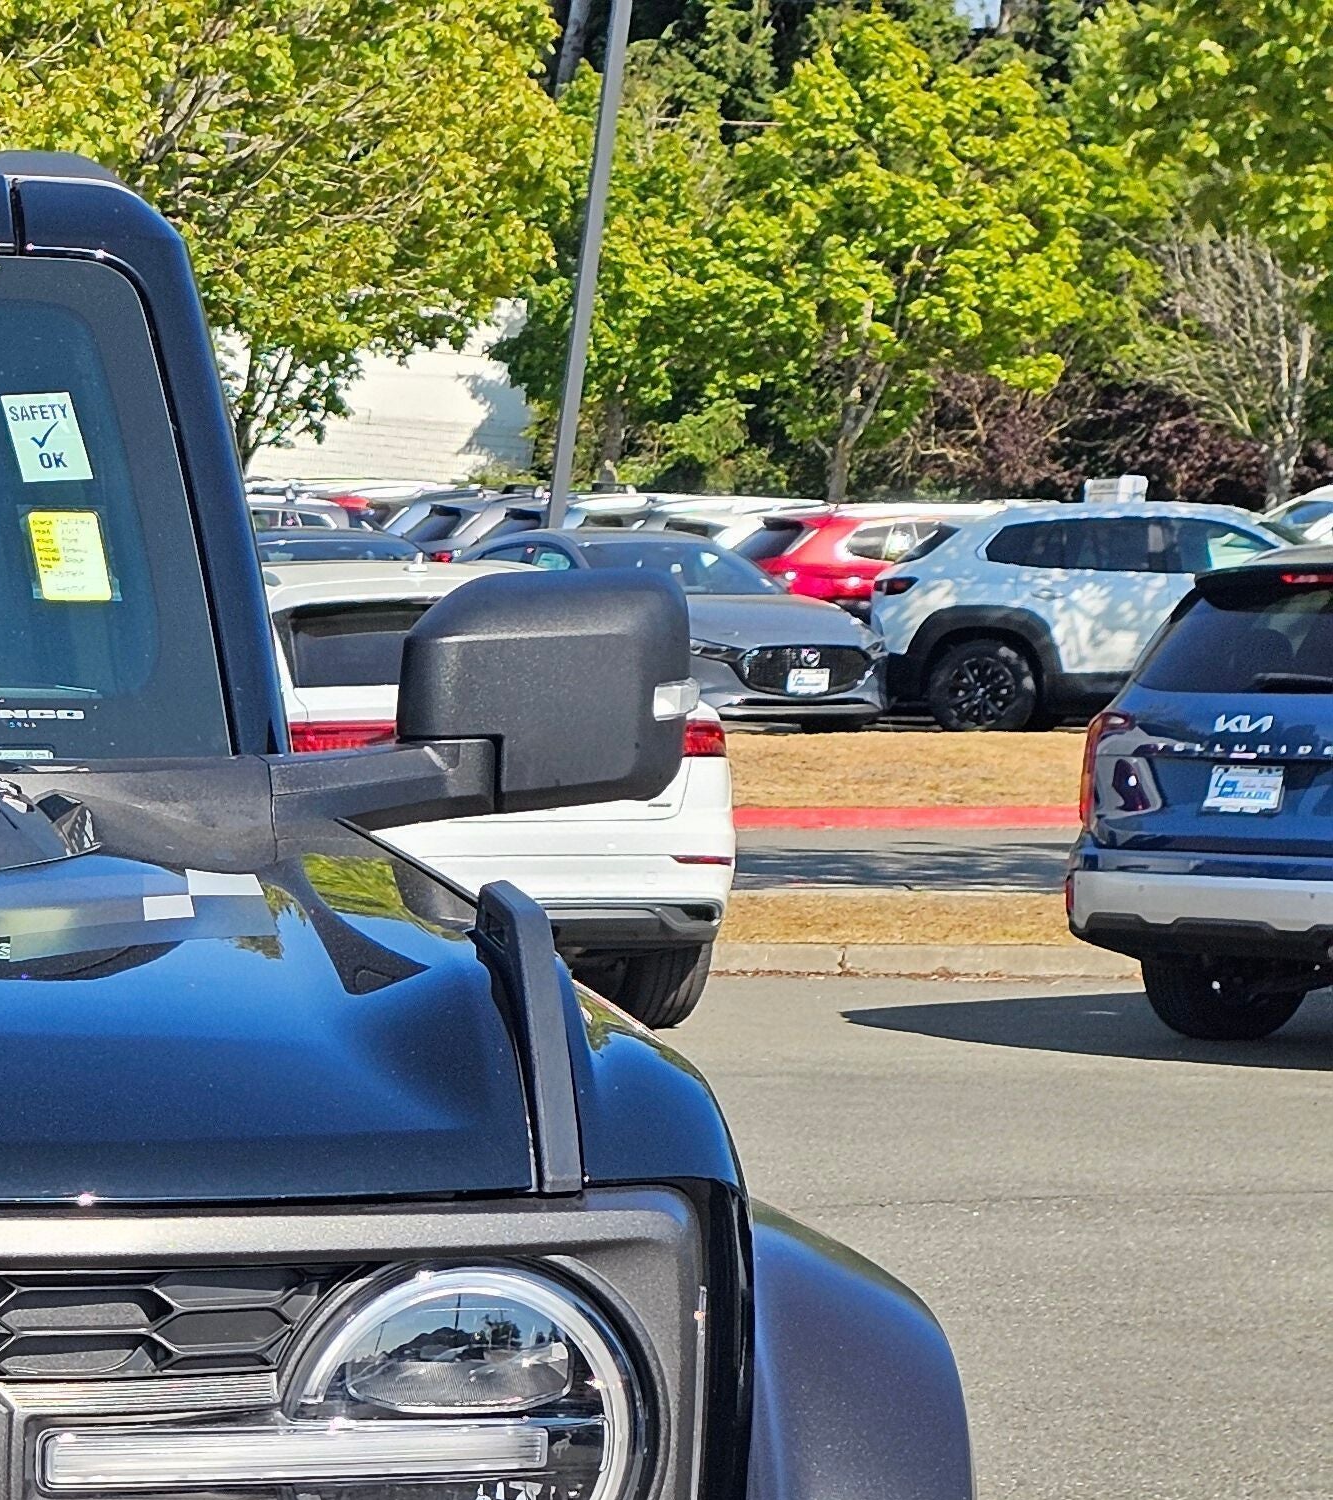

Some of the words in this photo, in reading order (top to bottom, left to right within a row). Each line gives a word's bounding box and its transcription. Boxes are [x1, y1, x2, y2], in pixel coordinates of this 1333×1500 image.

[8, 403, 68, 422] SAFETY
[38, 451, 68, 470] OK
[1213, 714, 1274, 734] KIA
